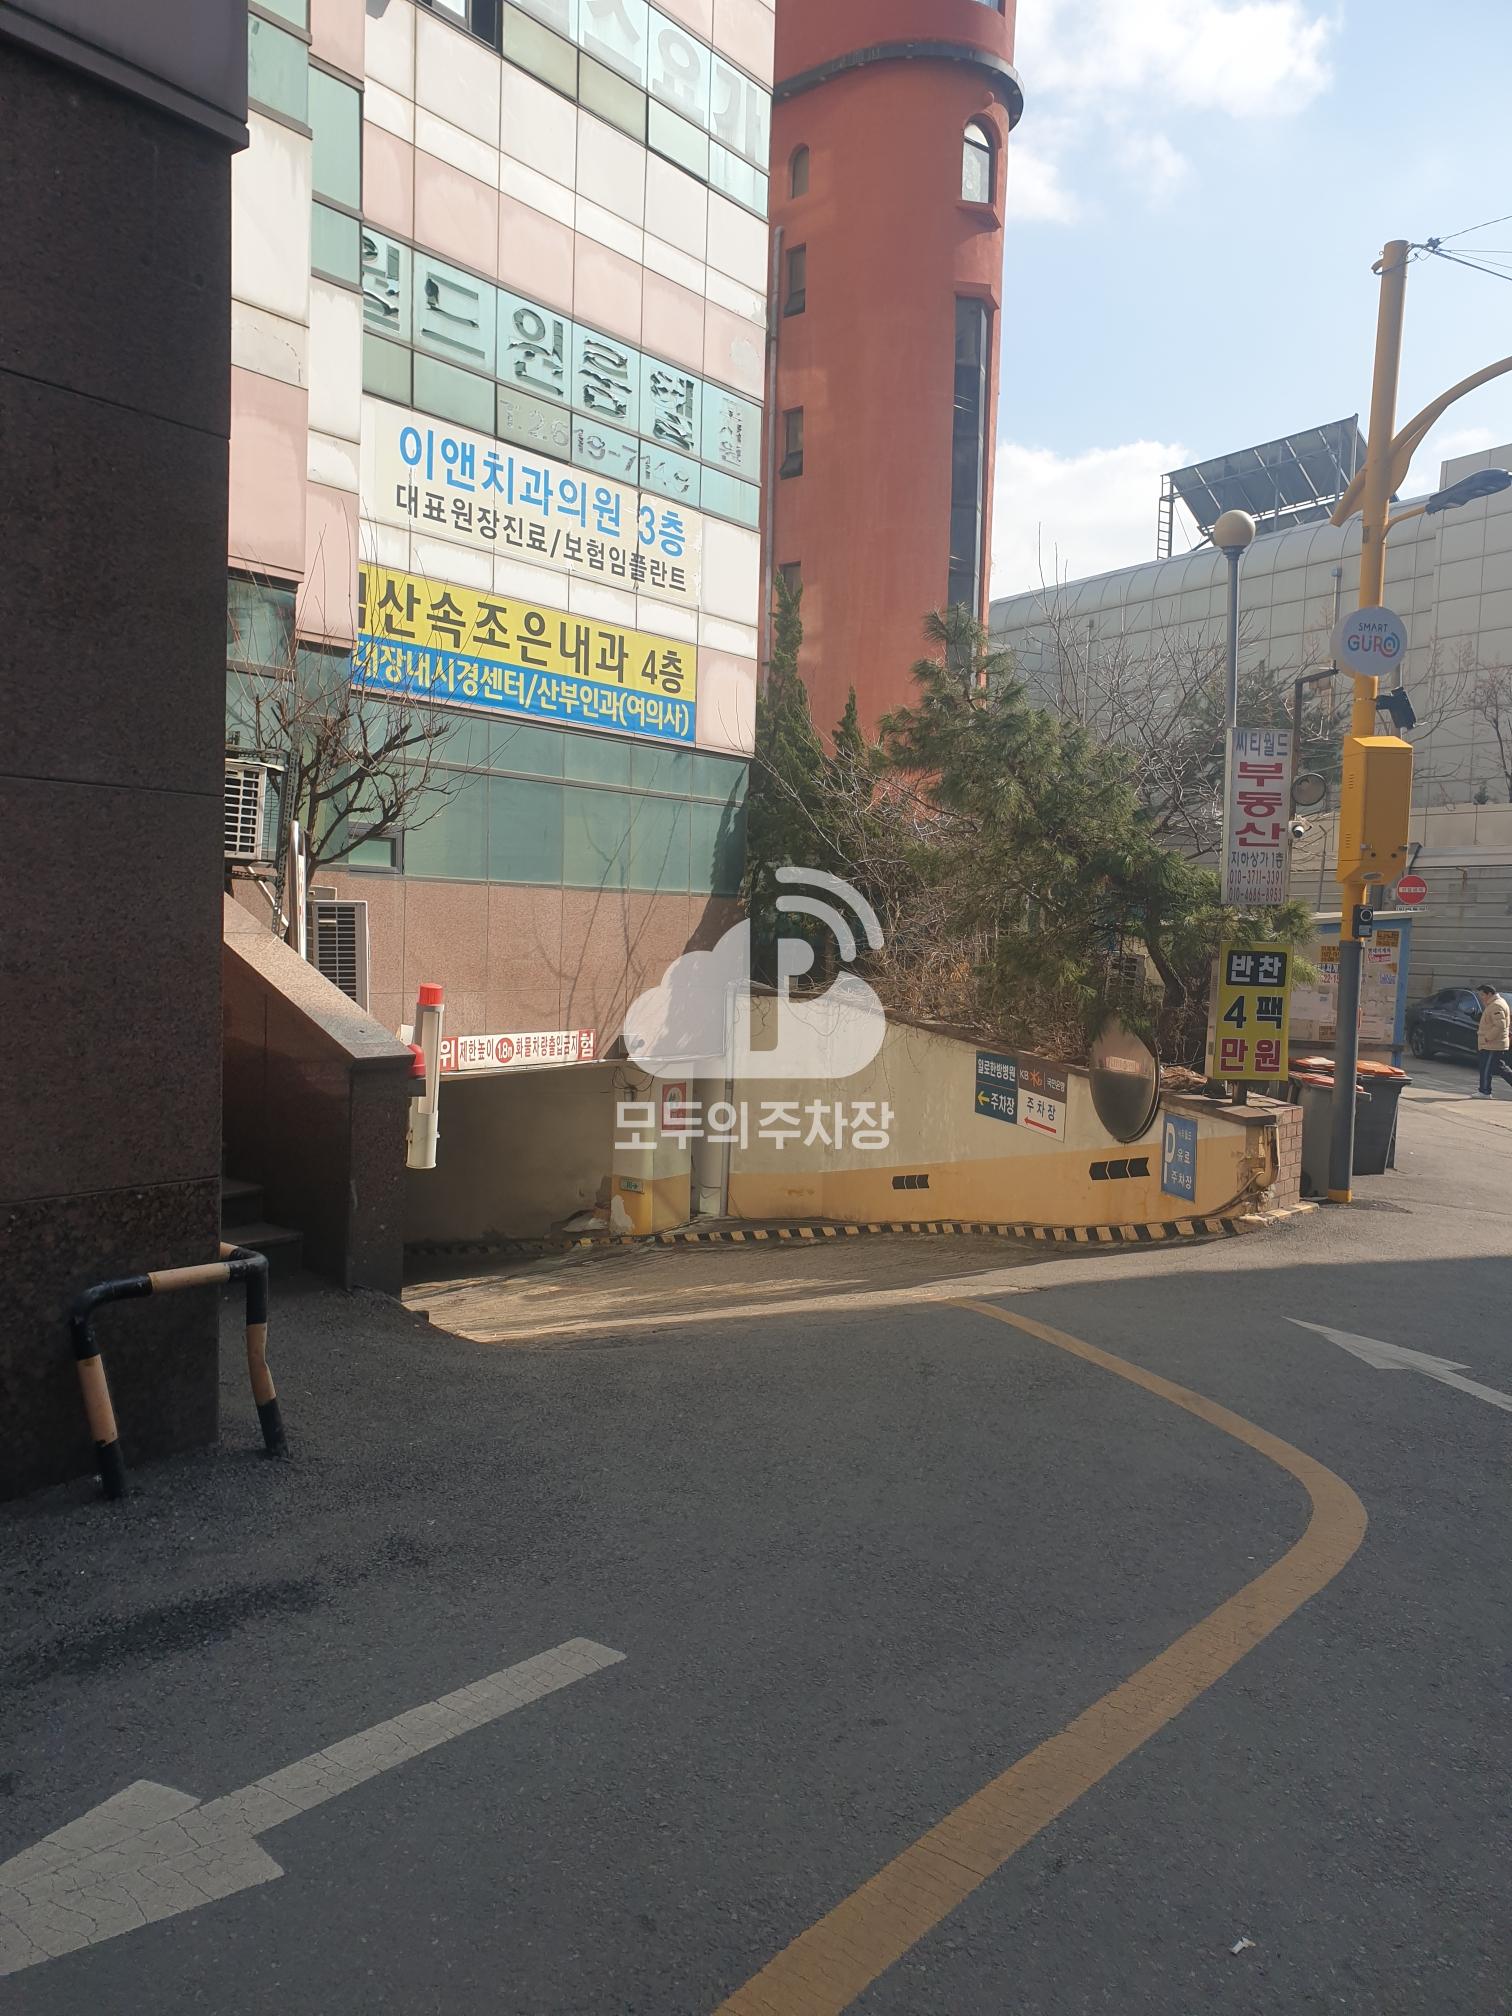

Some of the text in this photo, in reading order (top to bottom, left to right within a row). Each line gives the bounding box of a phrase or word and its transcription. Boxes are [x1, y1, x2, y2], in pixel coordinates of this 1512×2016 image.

[400, 426, 686, 557] 이앤치과의원 3층
[396, 484, 687, 592] 대표원장진료/보험임플란트
[1358, 622, 1389, 633] SMART
[1347, 632, 1400, 658] GURO
[641, 649, 684, 694] 4층
[1236, 731, 1288, 757] 씨티월드
[1235, 761, 1287, 848] 부동산
[459, 1037, 494, 1063] 제한높이
[1019, 1069, 1030, 1081] KB
[991, 1092, 1016, 1116] 주차장
[1170, 1170, 1193, 1191] 주차장
